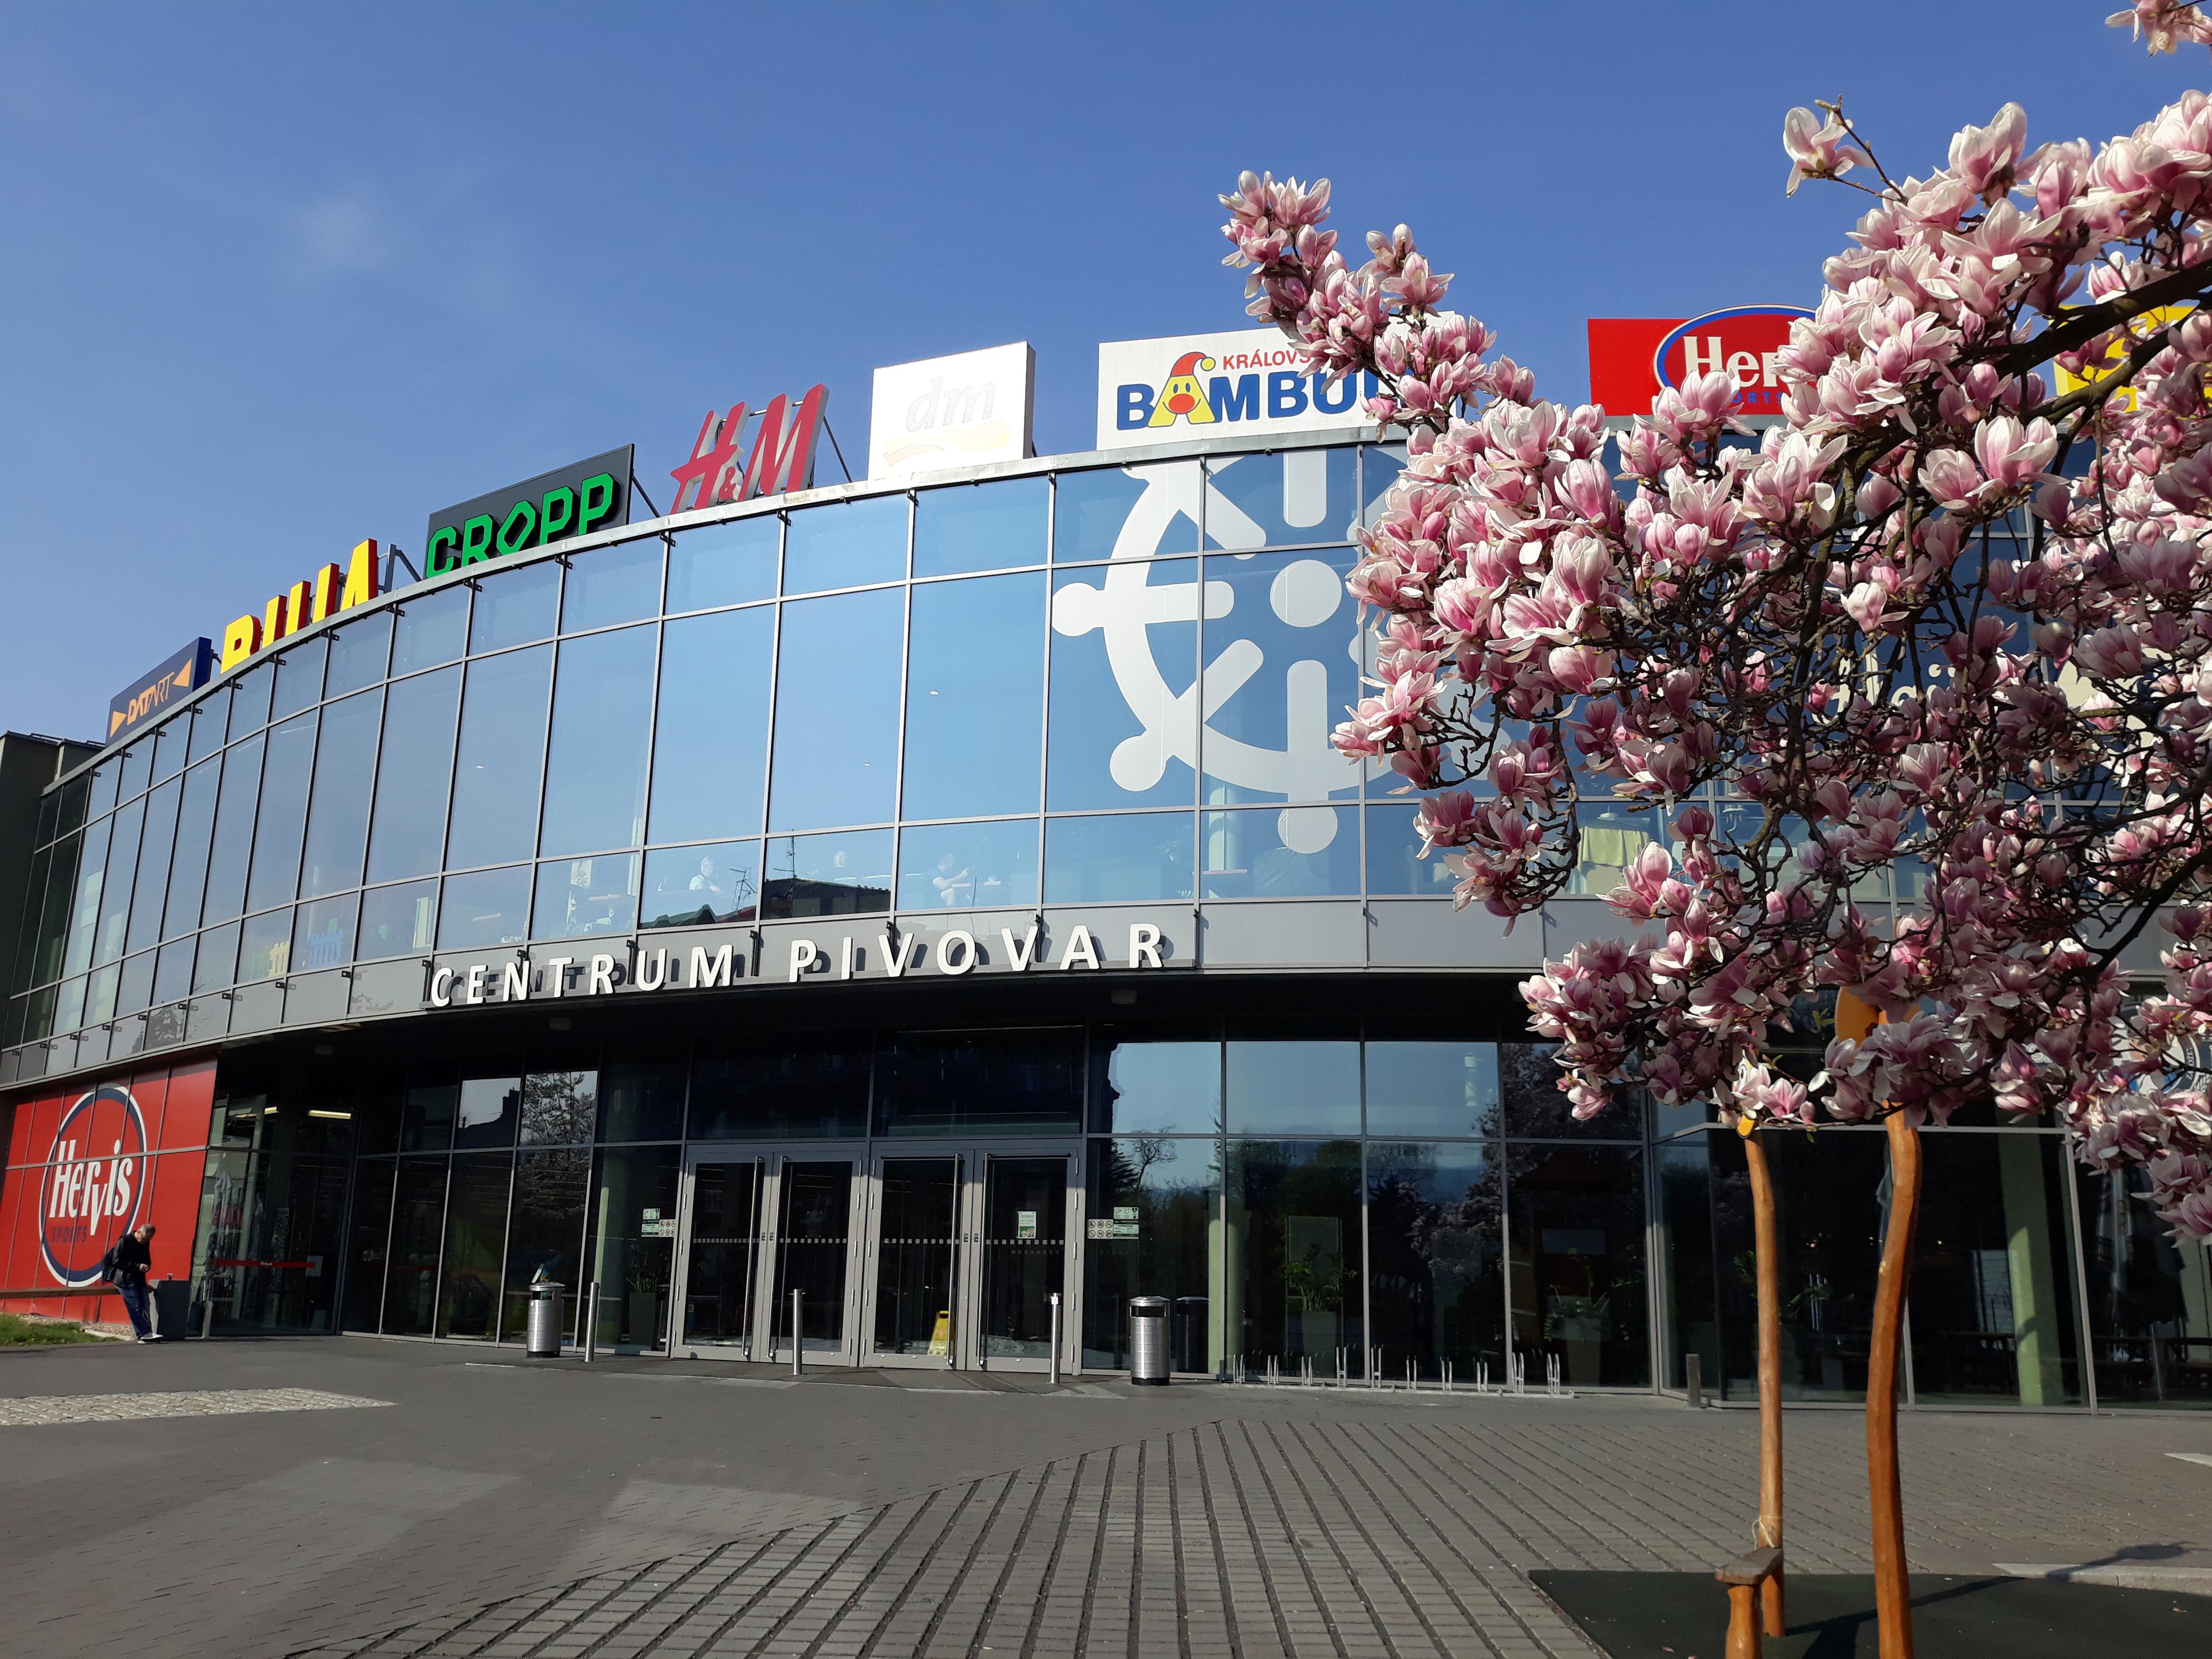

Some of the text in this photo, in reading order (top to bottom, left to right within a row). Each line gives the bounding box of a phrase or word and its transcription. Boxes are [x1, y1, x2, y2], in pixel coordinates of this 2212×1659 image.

[906, 376, 997, 432] dm
[1683, 336, 1795, 390] Her
[670, 383, 827, 514] H&M
[425, 472, 615, 579] CROPP
[127, 671, 175, 726] DATART
[430, 922, 1164, 1008] CENTRUM PIVOVAR
[49, 1139, 133, 1237] Hervis
